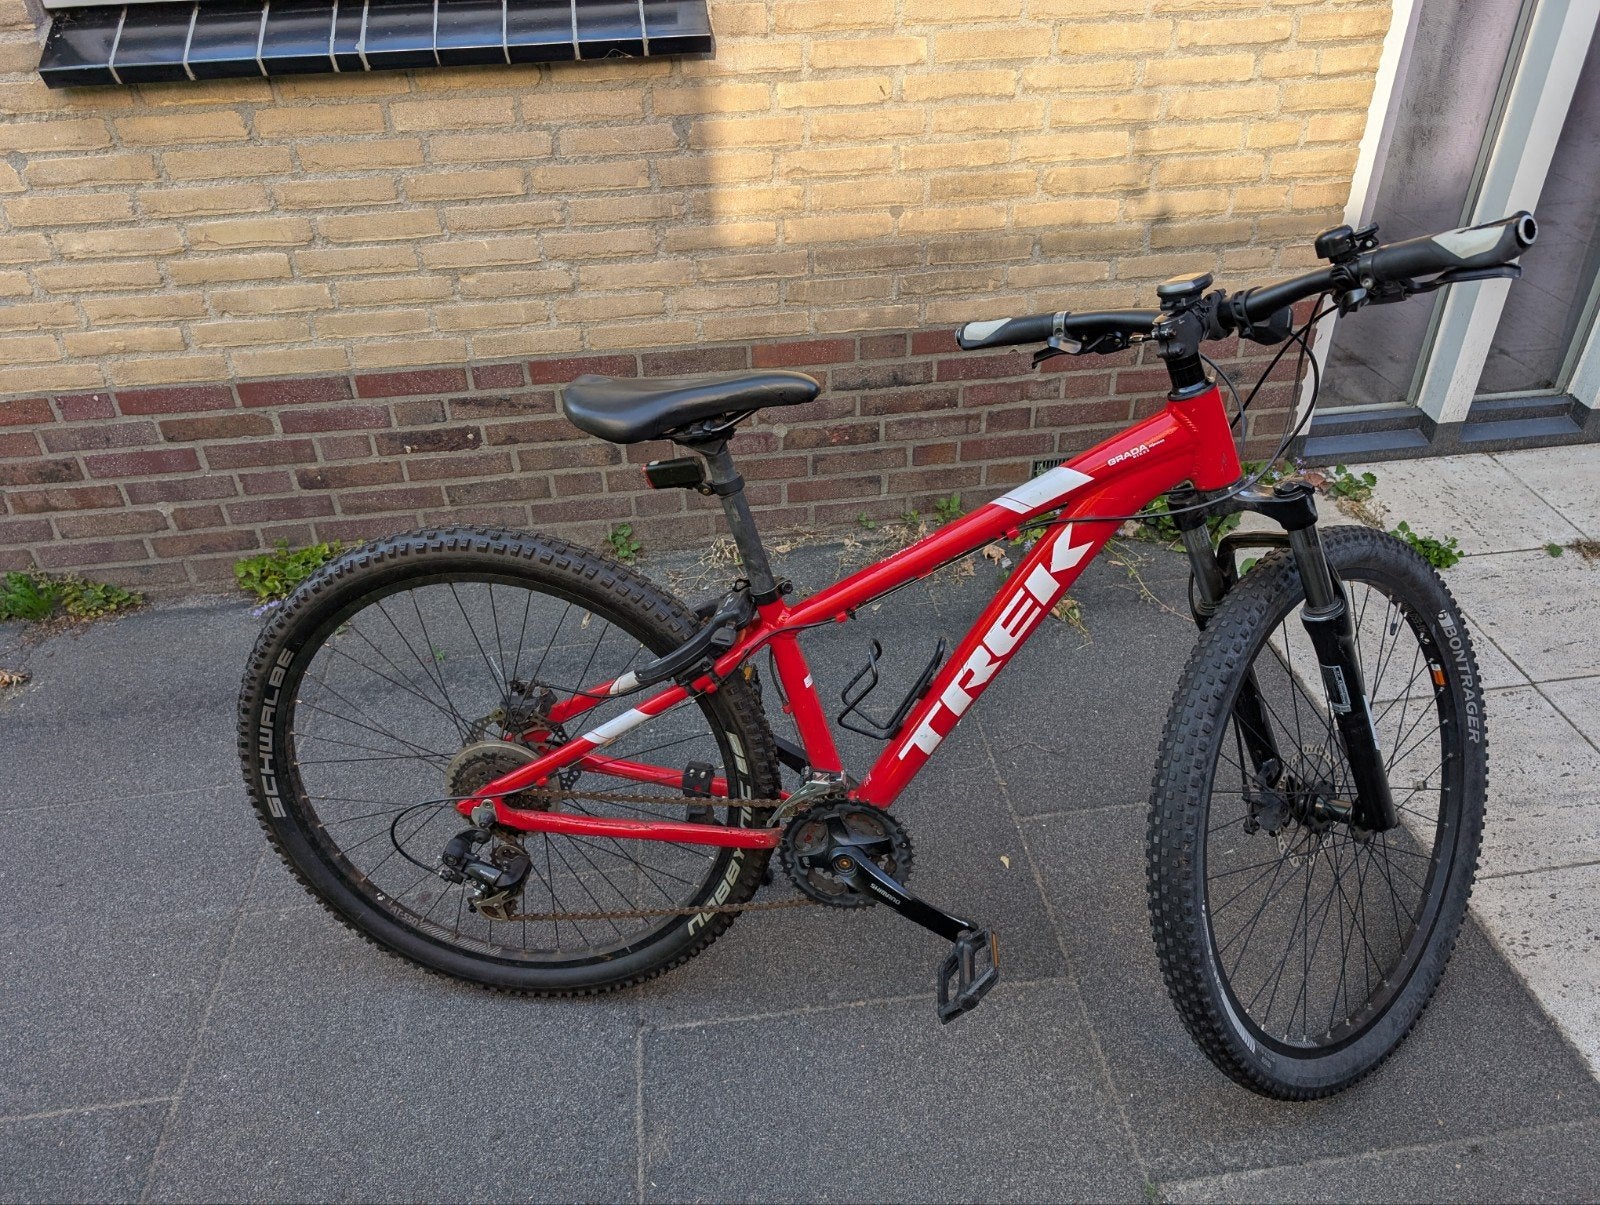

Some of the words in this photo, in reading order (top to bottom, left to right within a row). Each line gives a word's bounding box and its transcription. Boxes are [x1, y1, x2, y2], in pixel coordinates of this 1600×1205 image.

[1107, 444, 1149, 467] GRADA
[898, 523, 1094, 760] TREK
[1442, 626, 1480, 744] BONTRAGER
[259, 647, 295, 818] SCHWALBE
[870, 882, 901, 905] SHIMANO
